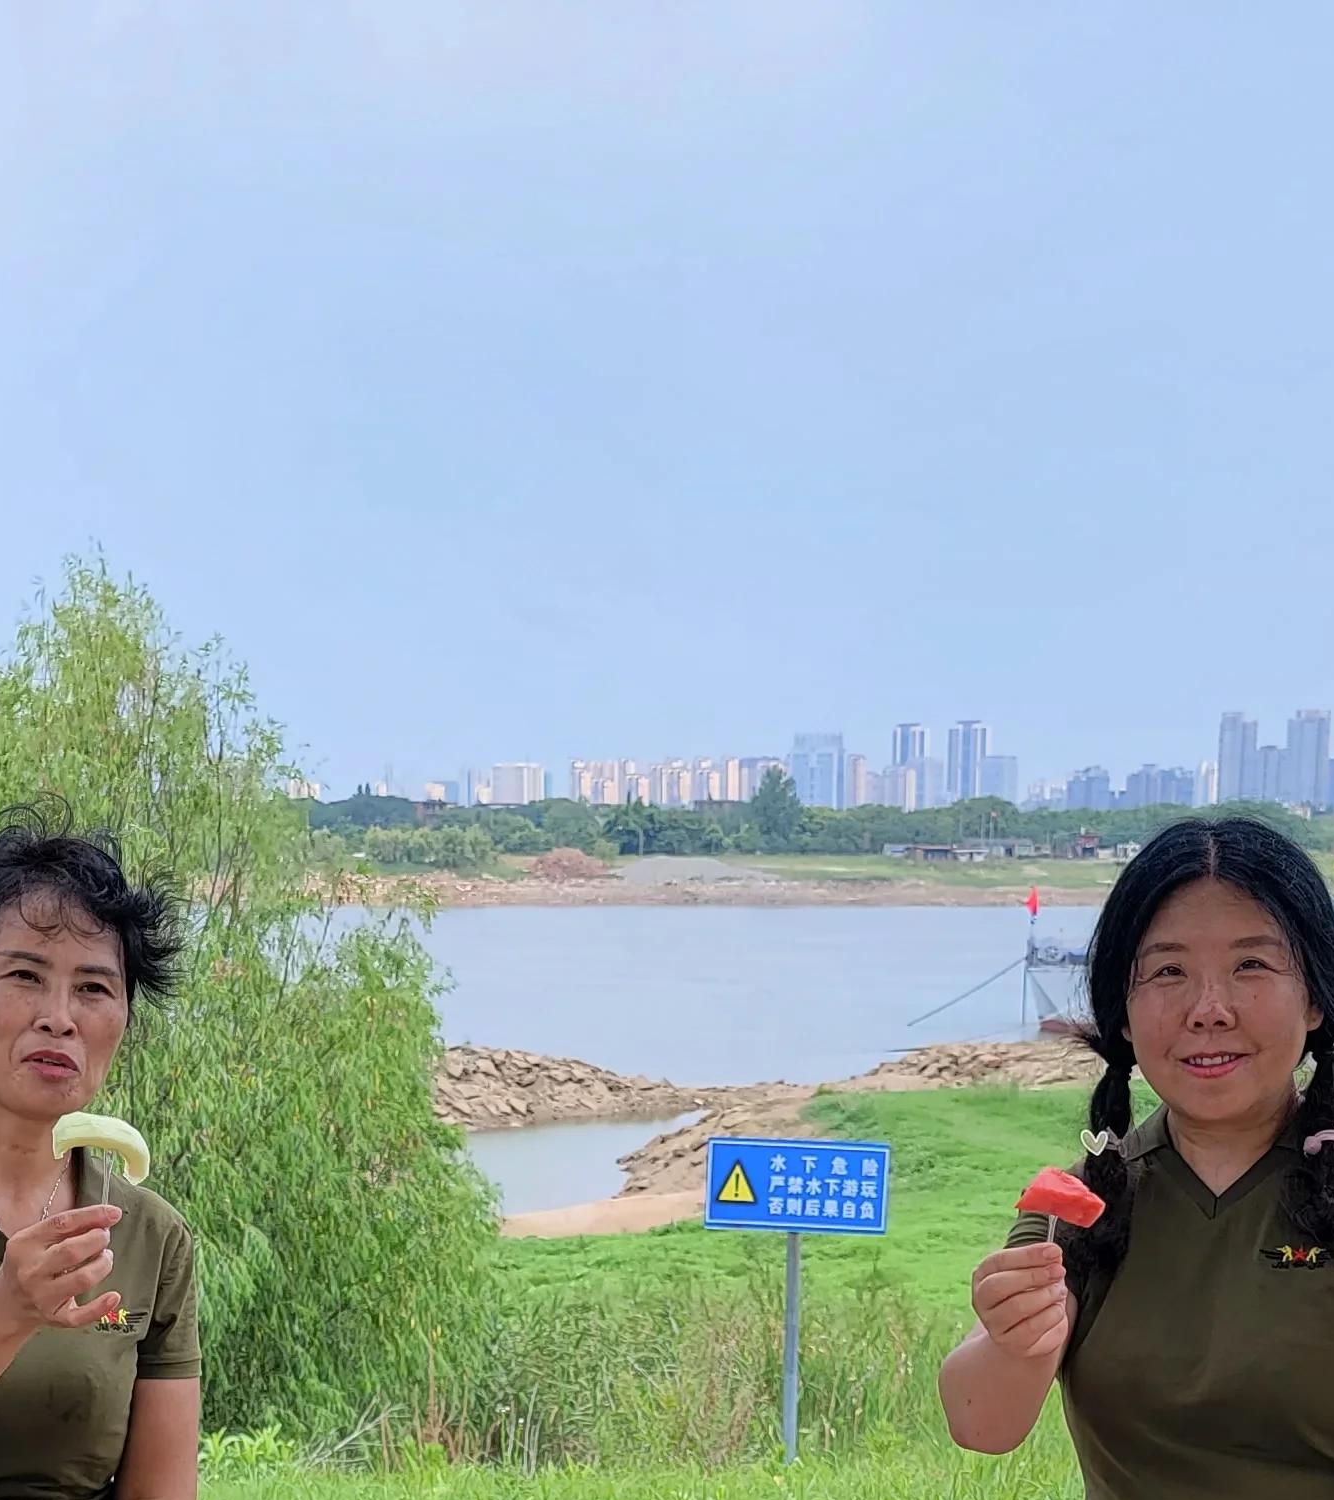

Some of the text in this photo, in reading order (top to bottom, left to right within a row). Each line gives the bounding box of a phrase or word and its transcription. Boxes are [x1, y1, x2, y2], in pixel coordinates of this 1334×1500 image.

[770, 1153, 880, 1177] 水下危险
[769, 1175, 878, 1199] 严禁水下游玩
[768, 1197, 875, 1220] 否则后果自负
